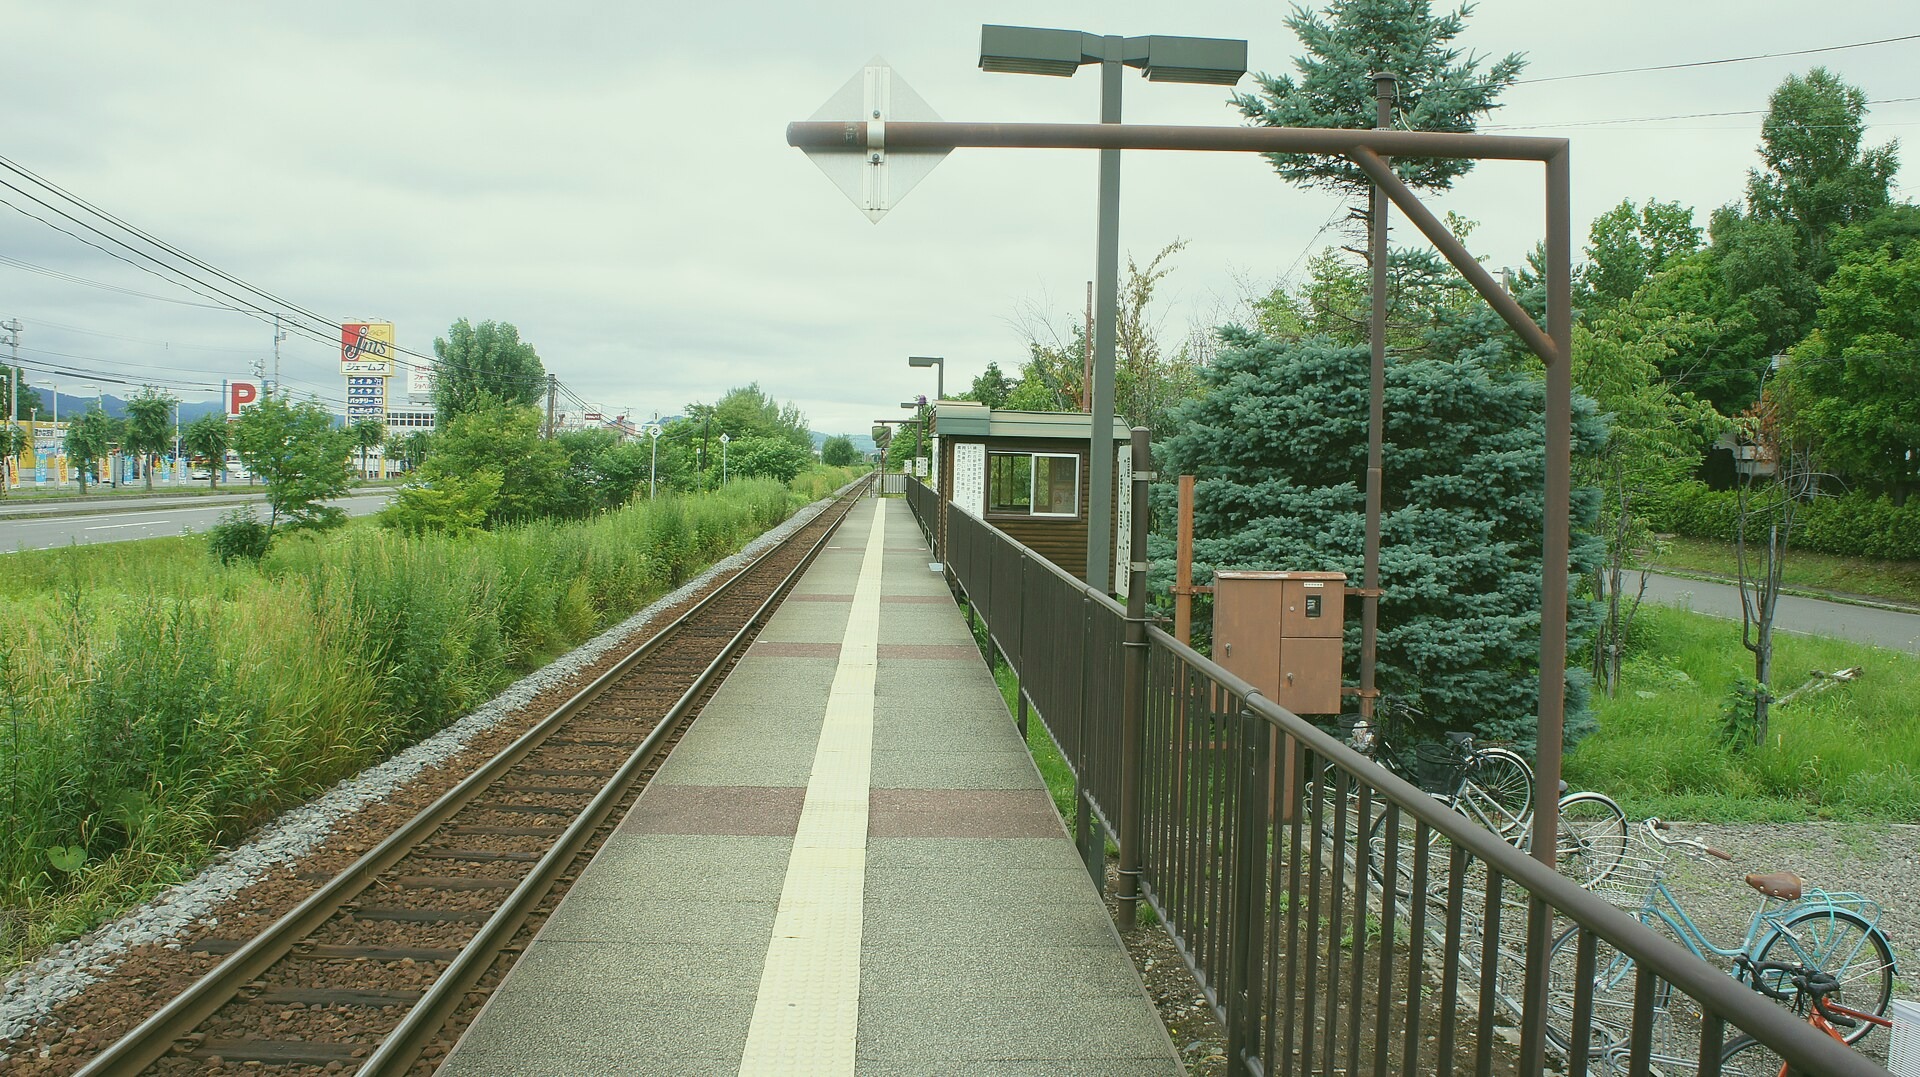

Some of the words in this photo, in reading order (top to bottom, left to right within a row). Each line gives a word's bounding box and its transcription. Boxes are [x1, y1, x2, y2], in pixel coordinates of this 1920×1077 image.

[346, 363, 386, 371] ジェームス
[231, 383, 256, 414] P
[652, 428, 658, 436] 2
